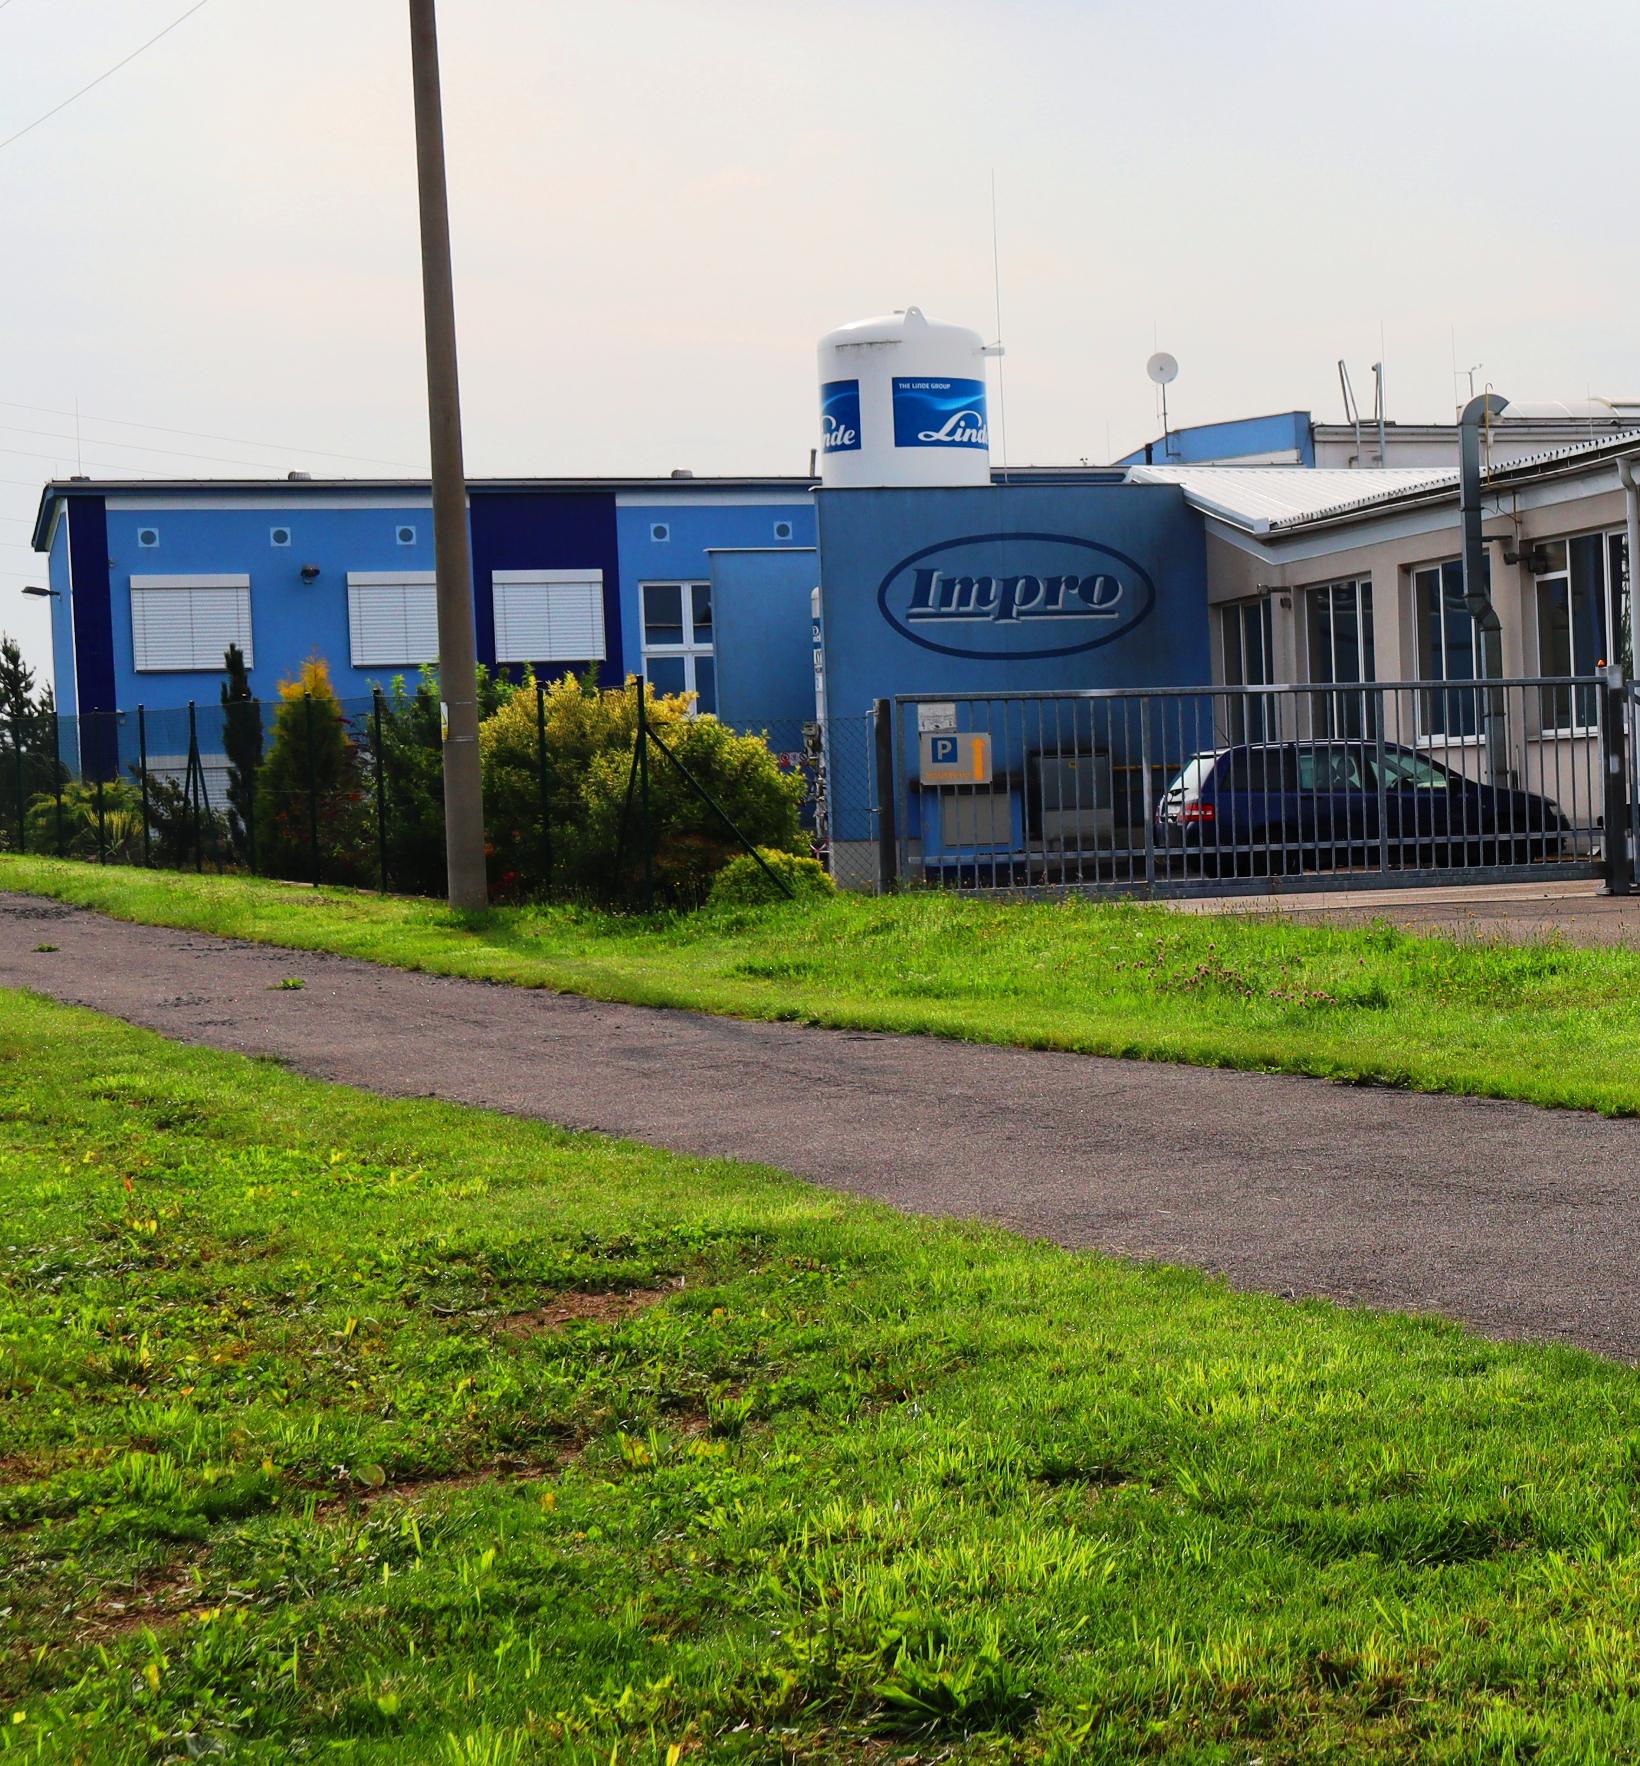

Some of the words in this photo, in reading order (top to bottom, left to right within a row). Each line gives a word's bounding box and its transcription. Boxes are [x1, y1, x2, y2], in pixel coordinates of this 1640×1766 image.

[823, 415, 856, 448] nde
[918, 410, 988, 445] Lind
[906, 568, 1123, 624] Impro
[937, 740, 952, 760] P
